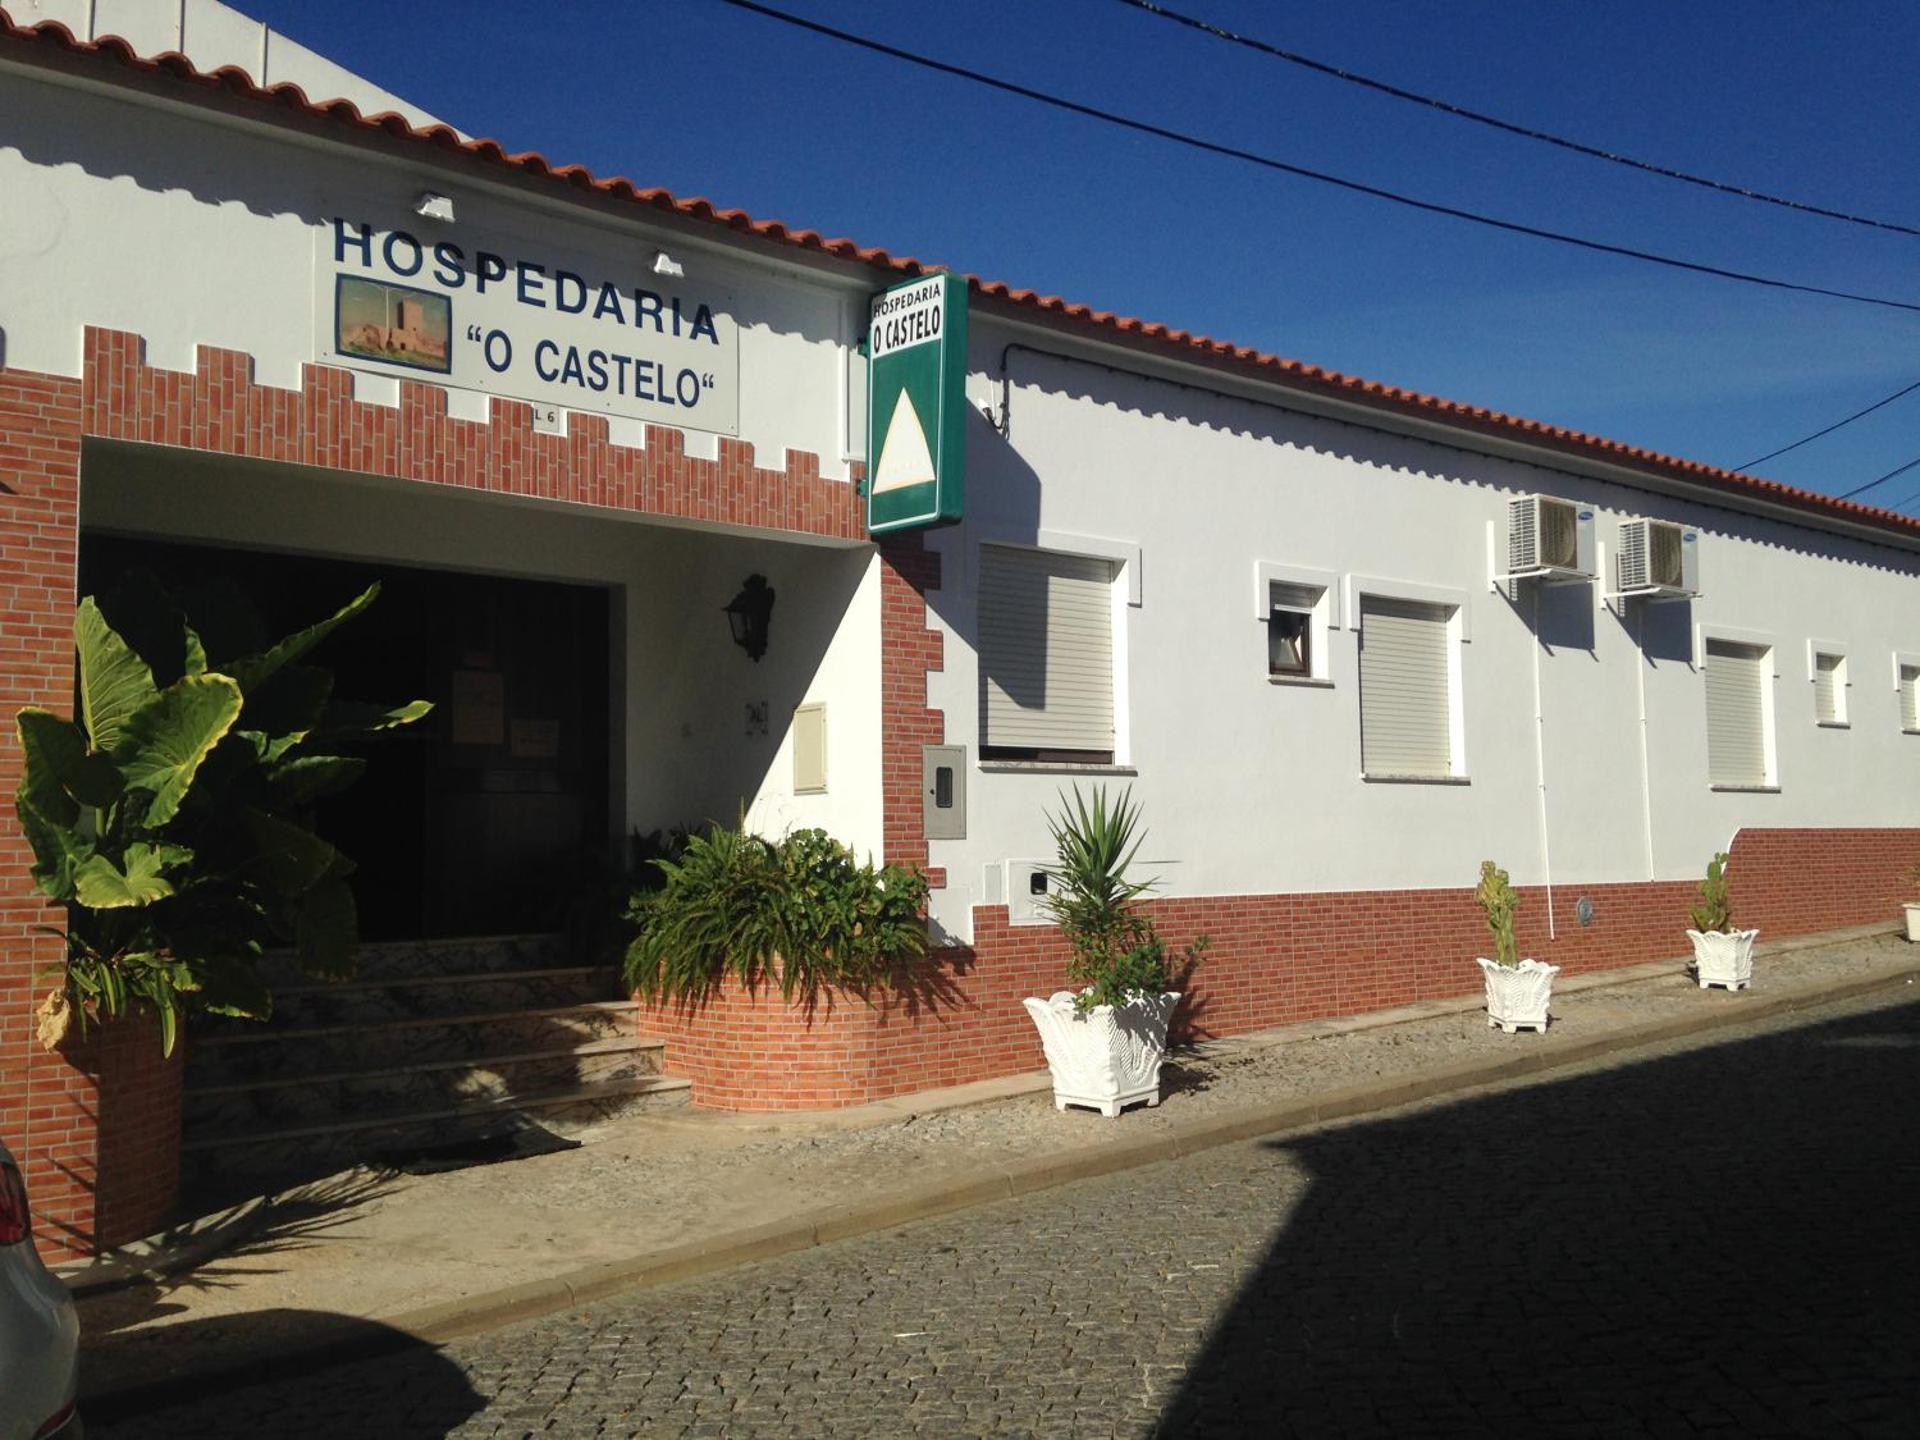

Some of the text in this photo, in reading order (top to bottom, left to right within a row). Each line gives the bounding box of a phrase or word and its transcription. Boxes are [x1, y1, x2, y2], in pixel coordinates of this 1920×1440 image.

[334, 216, 719, 345] HOSPEDARIA
[873, 283, 940, 318] HOSPEDARIA
[874, 305, 940, 354] O CASTELO
